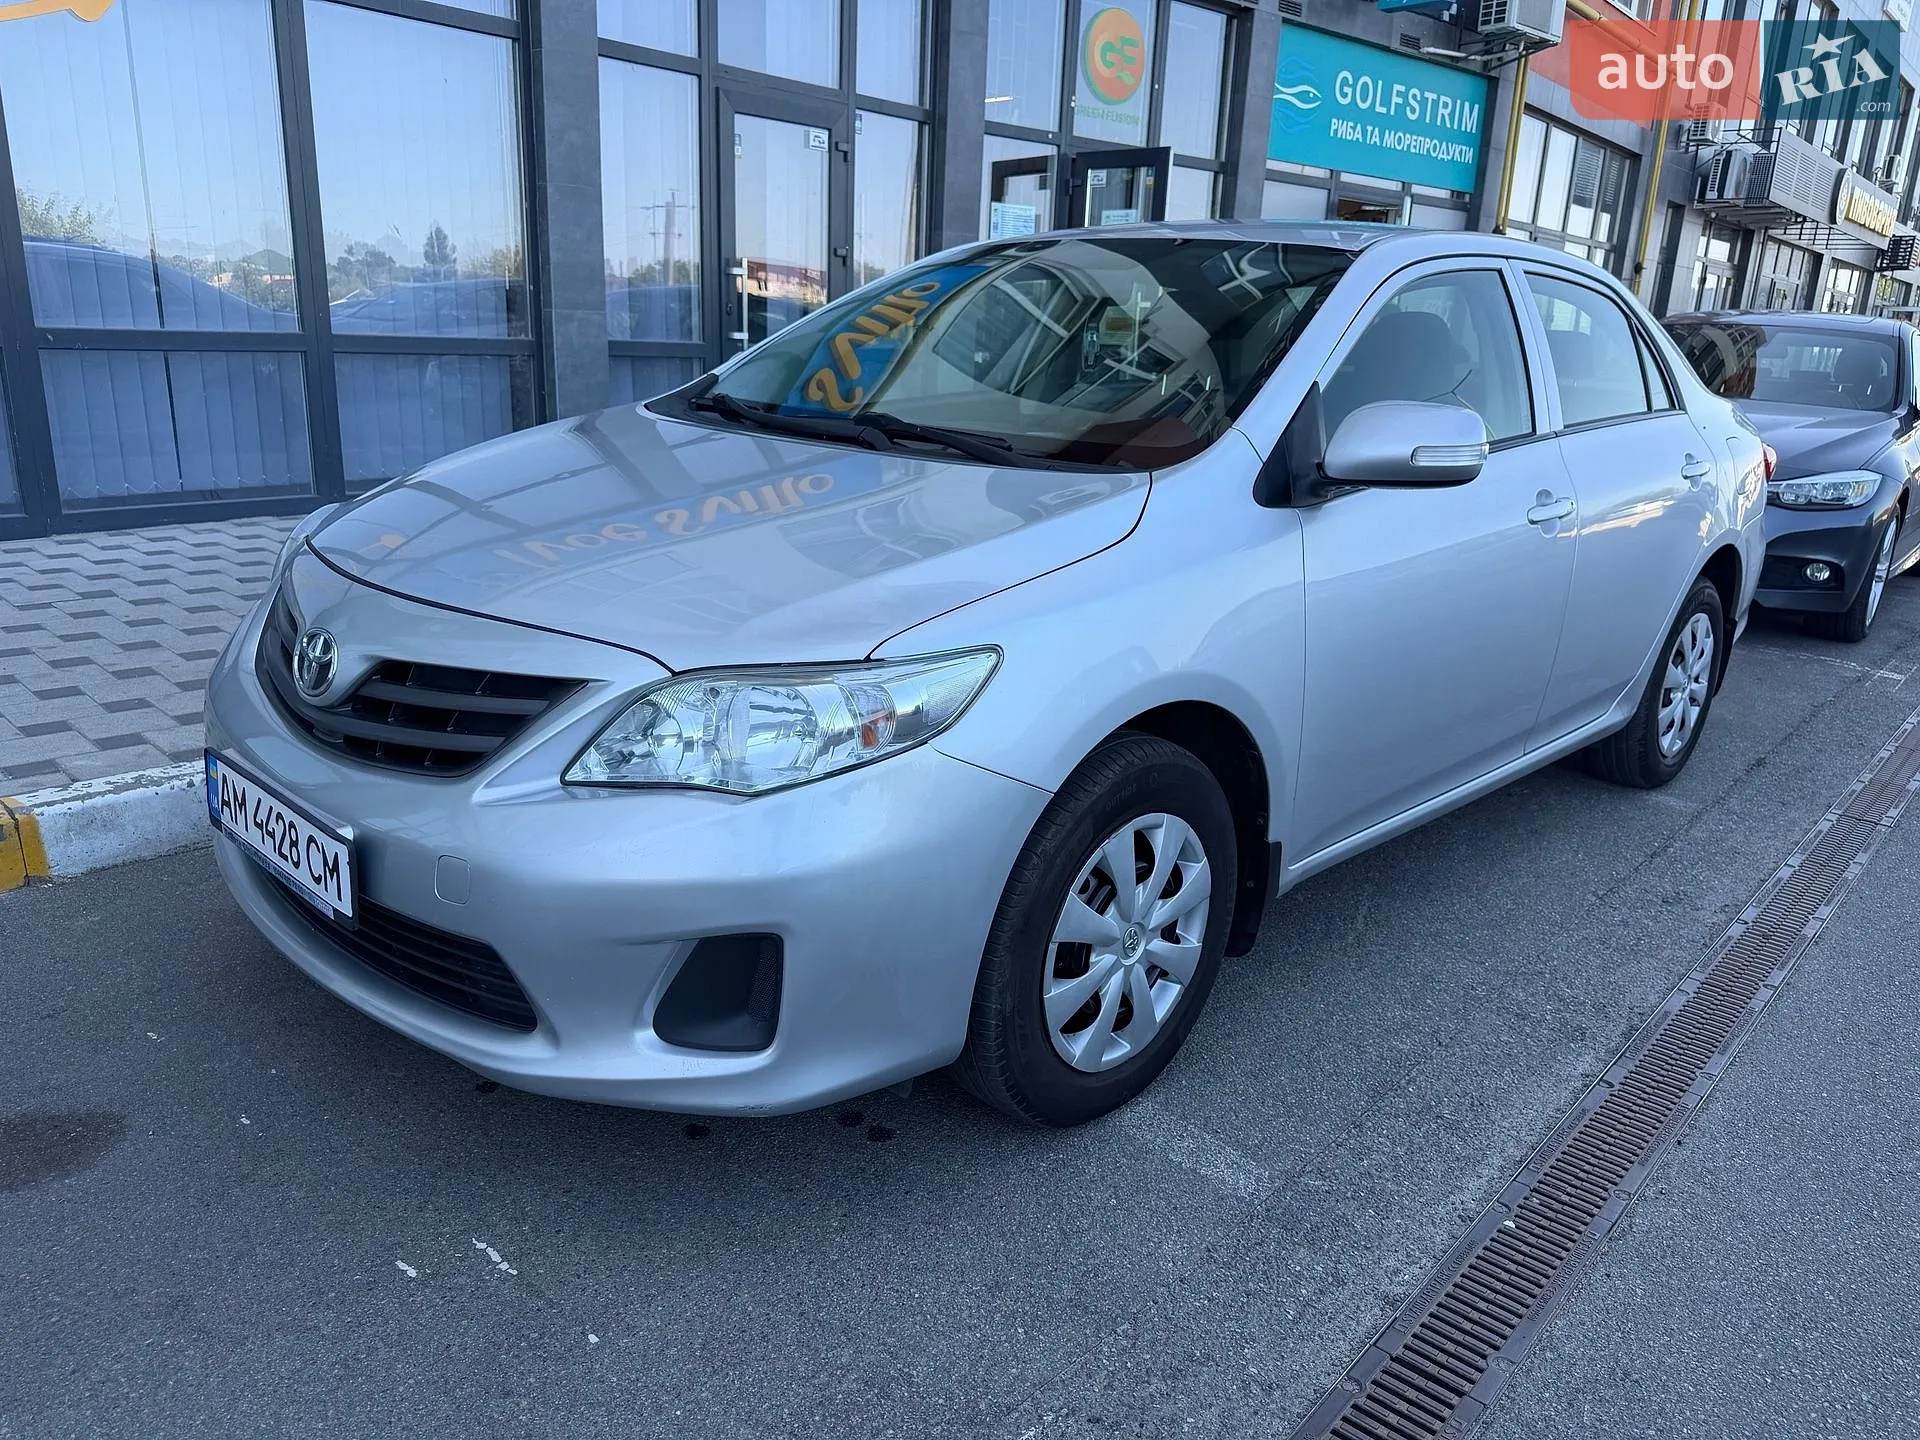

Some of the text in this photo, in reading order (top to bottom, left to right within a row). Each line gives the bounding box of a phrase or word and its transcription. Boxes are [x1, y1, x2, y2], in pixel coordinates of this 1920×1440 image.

[1335, 70, 1480, 134] GOLFSTRIM
[1330, 117, 1474, 165] РИБА ТА МОРЕПРОДУКТИ
[221, 772, 249, 833] AM
[253, 797, 301, 870] 4428
[306, 834, 343, 903] CM
